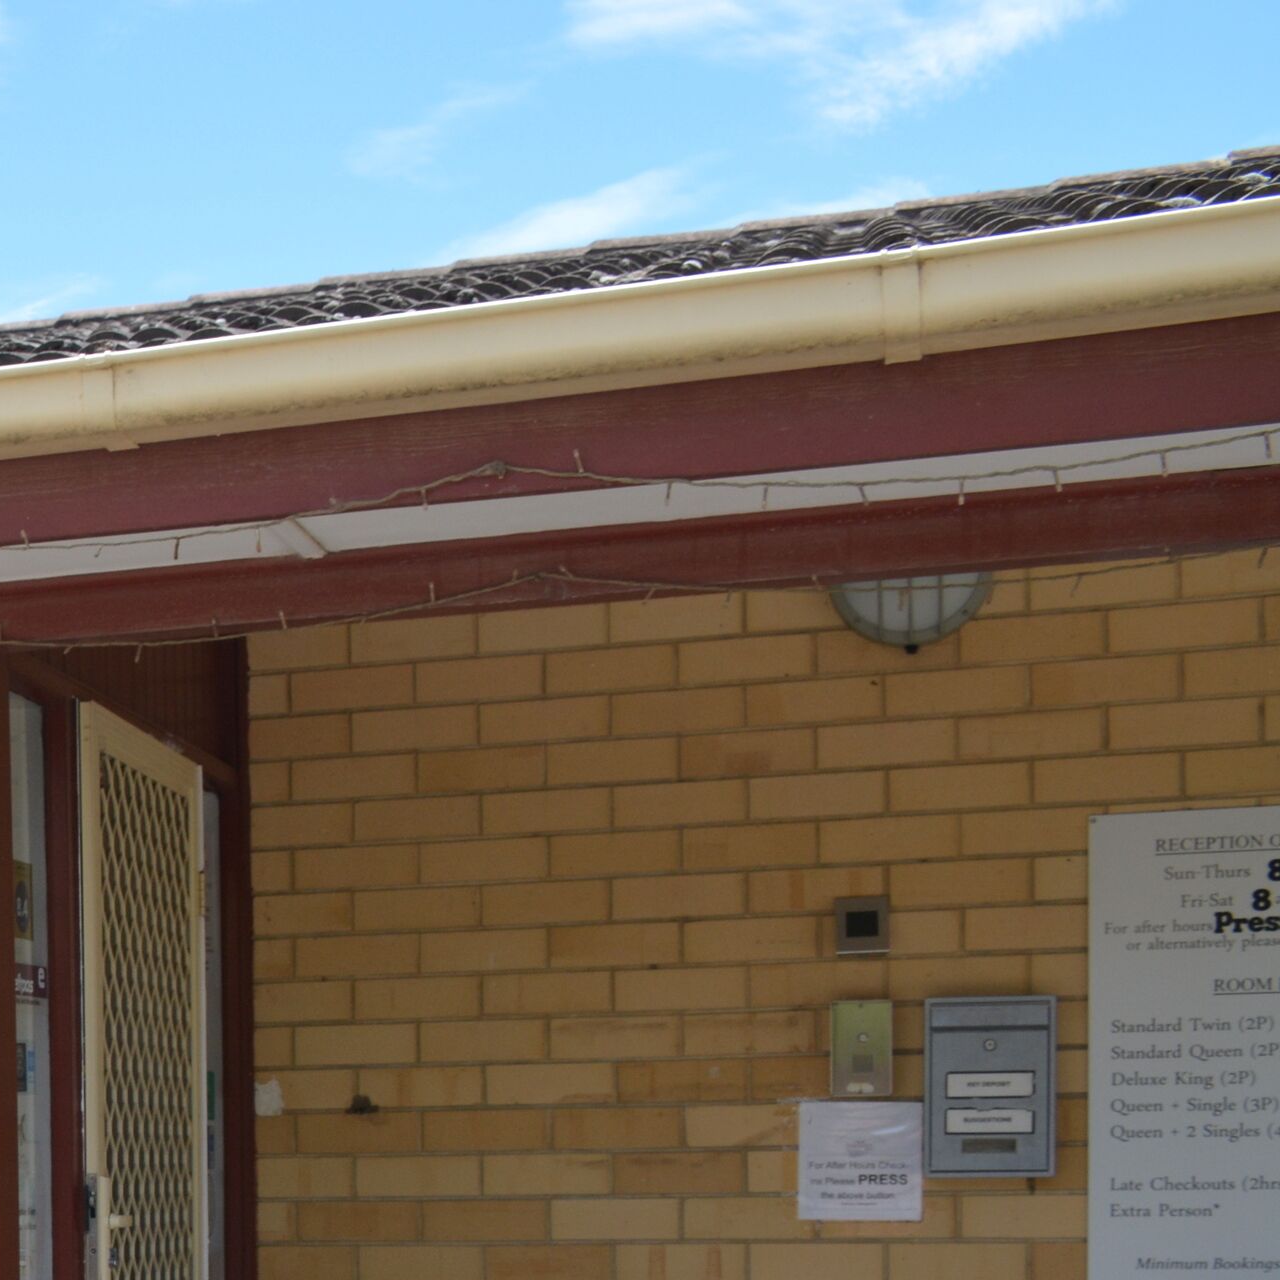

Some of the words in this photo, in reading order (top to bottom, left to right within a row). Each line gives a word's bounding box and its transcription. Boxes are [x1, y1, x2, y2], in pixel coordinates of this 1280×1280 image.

[1155, 834, 1264, 852] RECEPTION
[1163, 863, 1251, 880] Sun-Thurs
[1180, 892, 1234, 909] Fri-Sat
[1252, 888, 1272, 911] 8
[1104, 921, 1128, 935] For
[1133, 920, 1167, 934] after
[1172, 919, 1214, 933] hours
[1126, 941, 1141, 951] or
[1147, 935, 1235, 952] alternatively
[1213, 977, 1273, 993] ROOM
[1111, 1017, 1182, 1034] Standard
[1189, 1017, 1231, 1032] Twin
[1238, 1015, 1275, 1033] (2P)
[1111, 1044, 1182, 1060] Standard
[1189, 1043, 1243, 1062] Queen
[1111, 1071, 1167, 1086] Deluxe
[1174, 1071, 1215, 1090] King
[1220, 1070, 1257, 1087] (2P)
[1110, 1098, 1163, 1116] Queen
[1186, 1096, 1237, 1116] Single
[1243, 1096, 1279, 1113] (3P)
[1110, 1124, 1163, 1142] Queen
[1186, 1125, 1197, 1138] 2
[1202, 1122, 1260, 1143] Singles
[858, 1174, 908, 1185] PRESS
[1110, 1177, 1143, 1192] Late
[1149, 1175, 1237, 1191] Checkouts
[1109, 1203, 1151, 1218] Extra
[1135, 1257, 1208, 1270] Minimum
